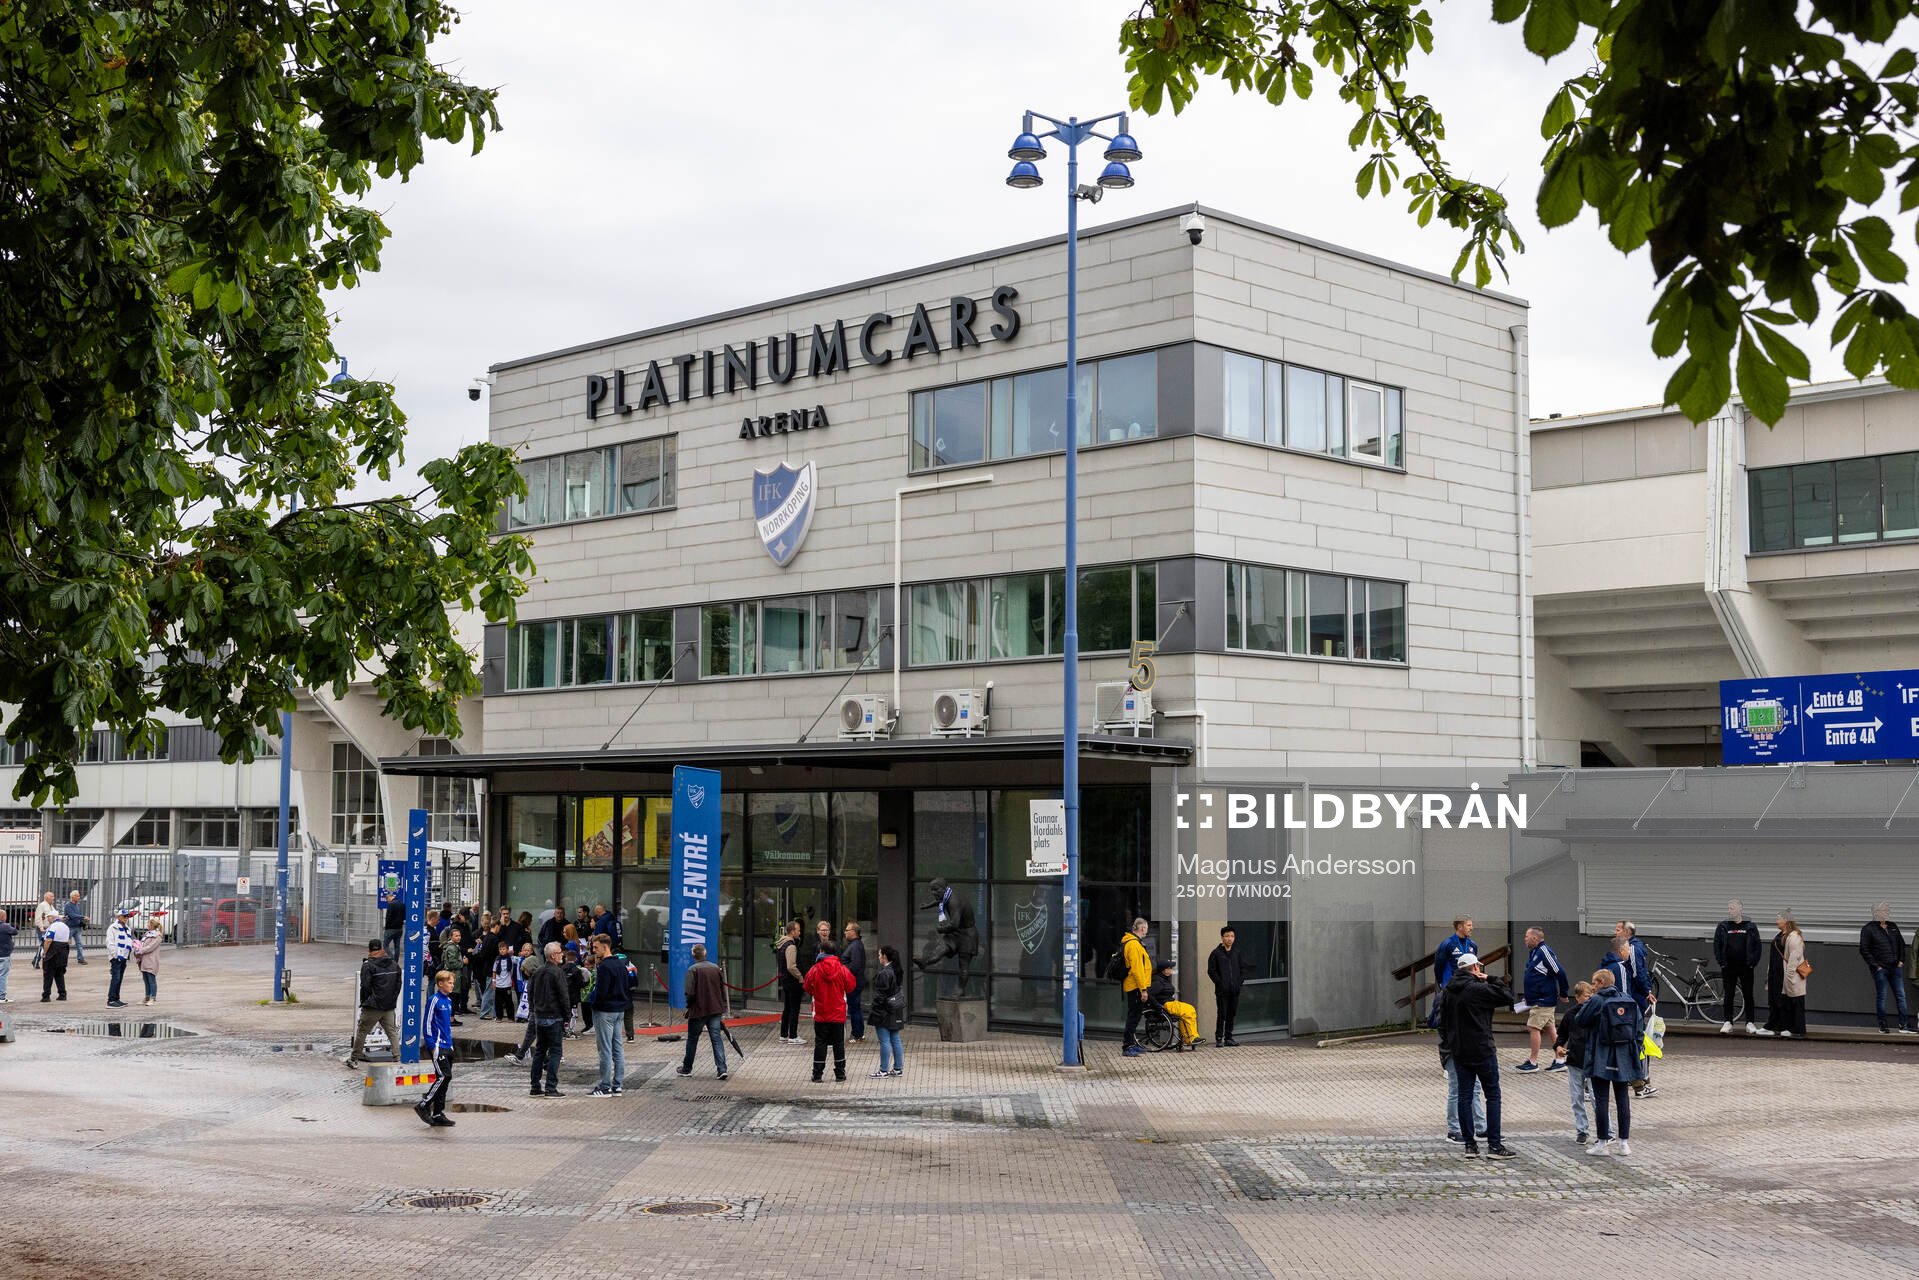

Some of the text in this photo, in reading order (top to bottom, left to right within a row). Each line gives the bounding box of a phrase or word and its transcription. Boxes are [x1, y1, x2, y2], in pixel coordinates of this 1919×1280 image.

[586, 285, 1020, 420] PLATINUMCARS
[738, 404, 829, 439] ARENA
[758, 482, 782, 501] IFK
[762, 481, 809, 538] NORRKÖPING
[1128, 640, 1156, 692] 5
[1813, 689, 1864, 708] Entré 4B
[1825, 727, 1876, 746] Entré 4A
[1033, 812, 1058, 824] Gunnar
[1033, 824, 1063, 836] Nordahls
[765, 850, 811, 860] Välkommen
[1033, 836, 1050, 851] plats
[411, 848, 420, 922] PEKING
[679, 831, 708, 945] VIP-ENTRÉ
[407, 951, 417, 1026] PEKING
